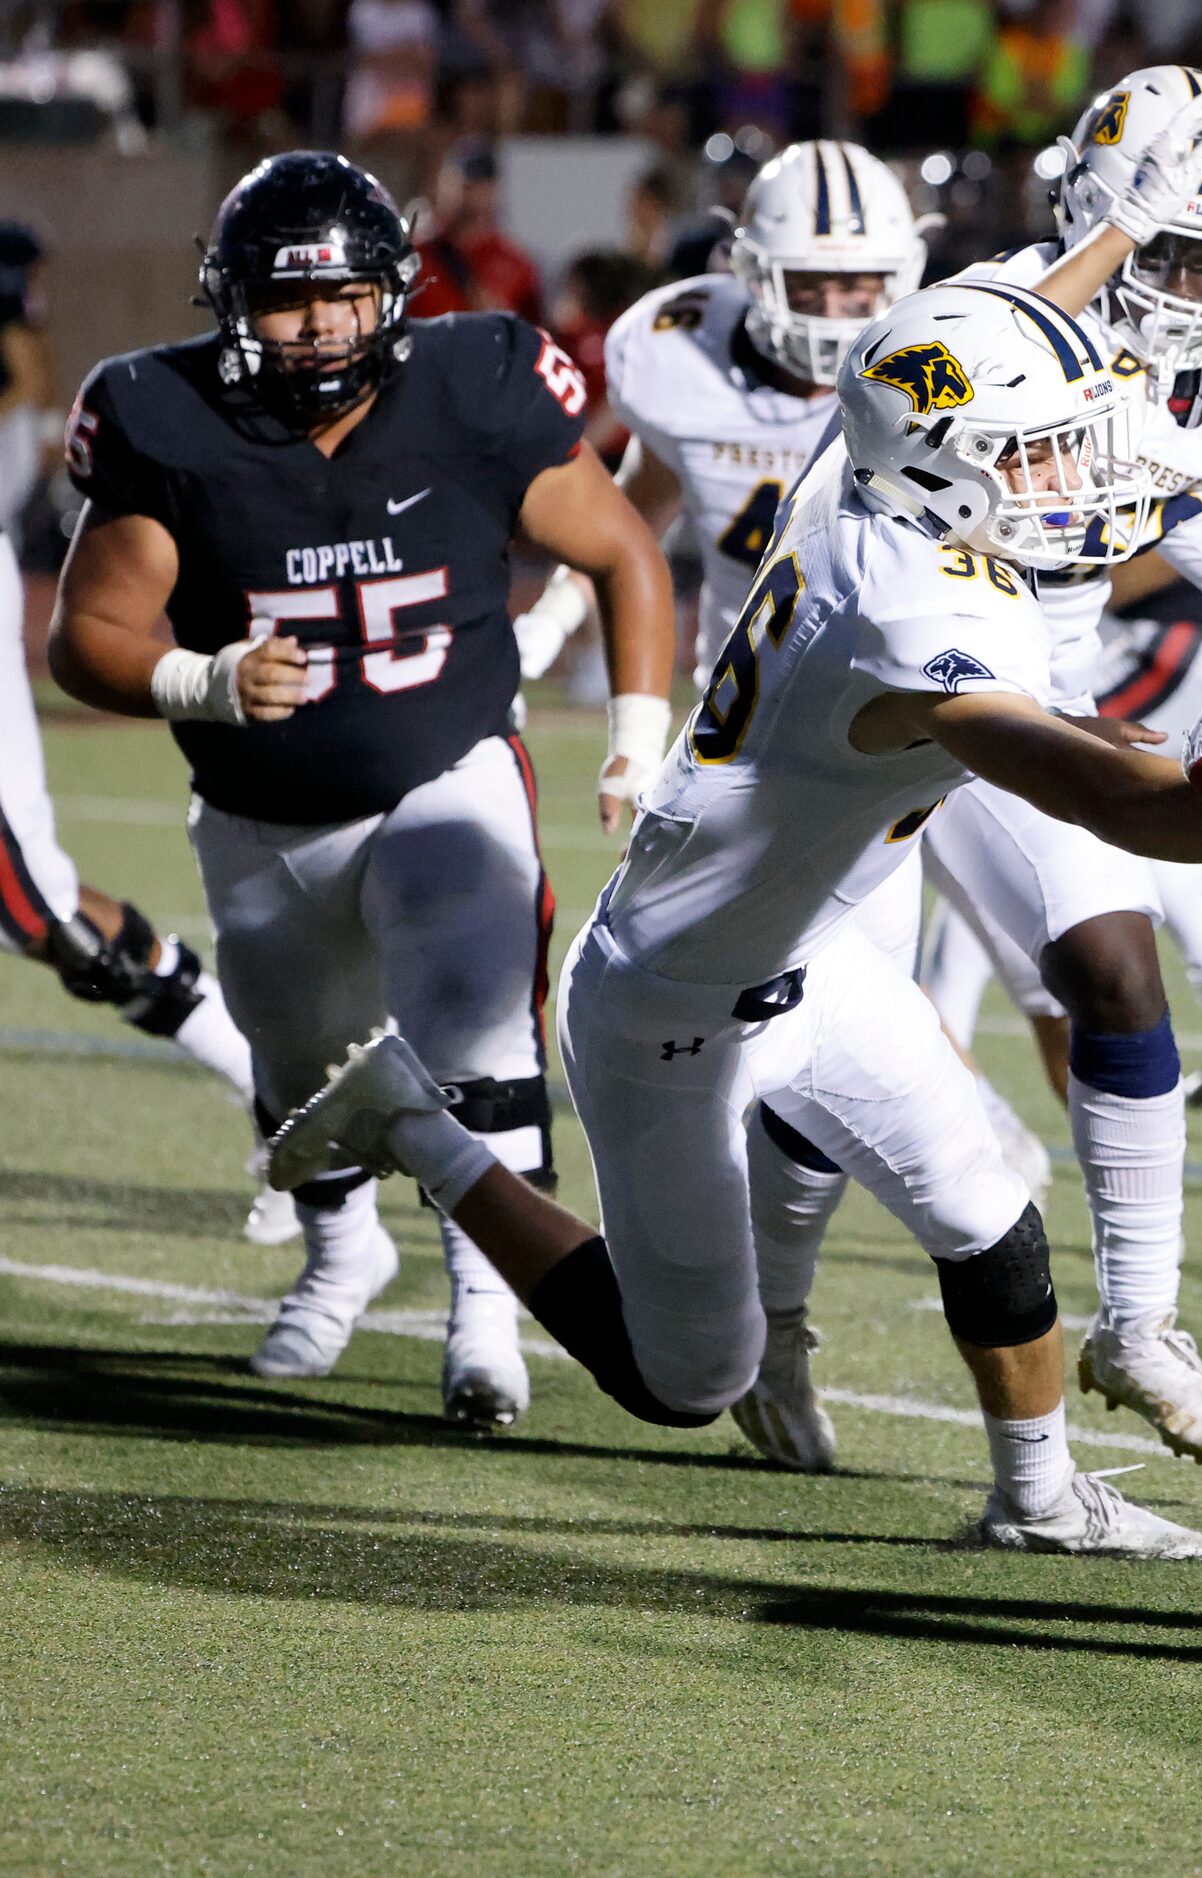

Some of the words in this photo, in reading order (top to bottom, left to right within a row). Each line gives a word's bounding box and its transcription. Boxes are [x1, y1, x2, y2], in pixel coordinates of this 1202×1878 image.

[533, 327, 588, 417] 5
[286, 536, 402, 584] COPPELL
[938, 543, 1020, 600] 36
[245, 566, 453, 701] 55
